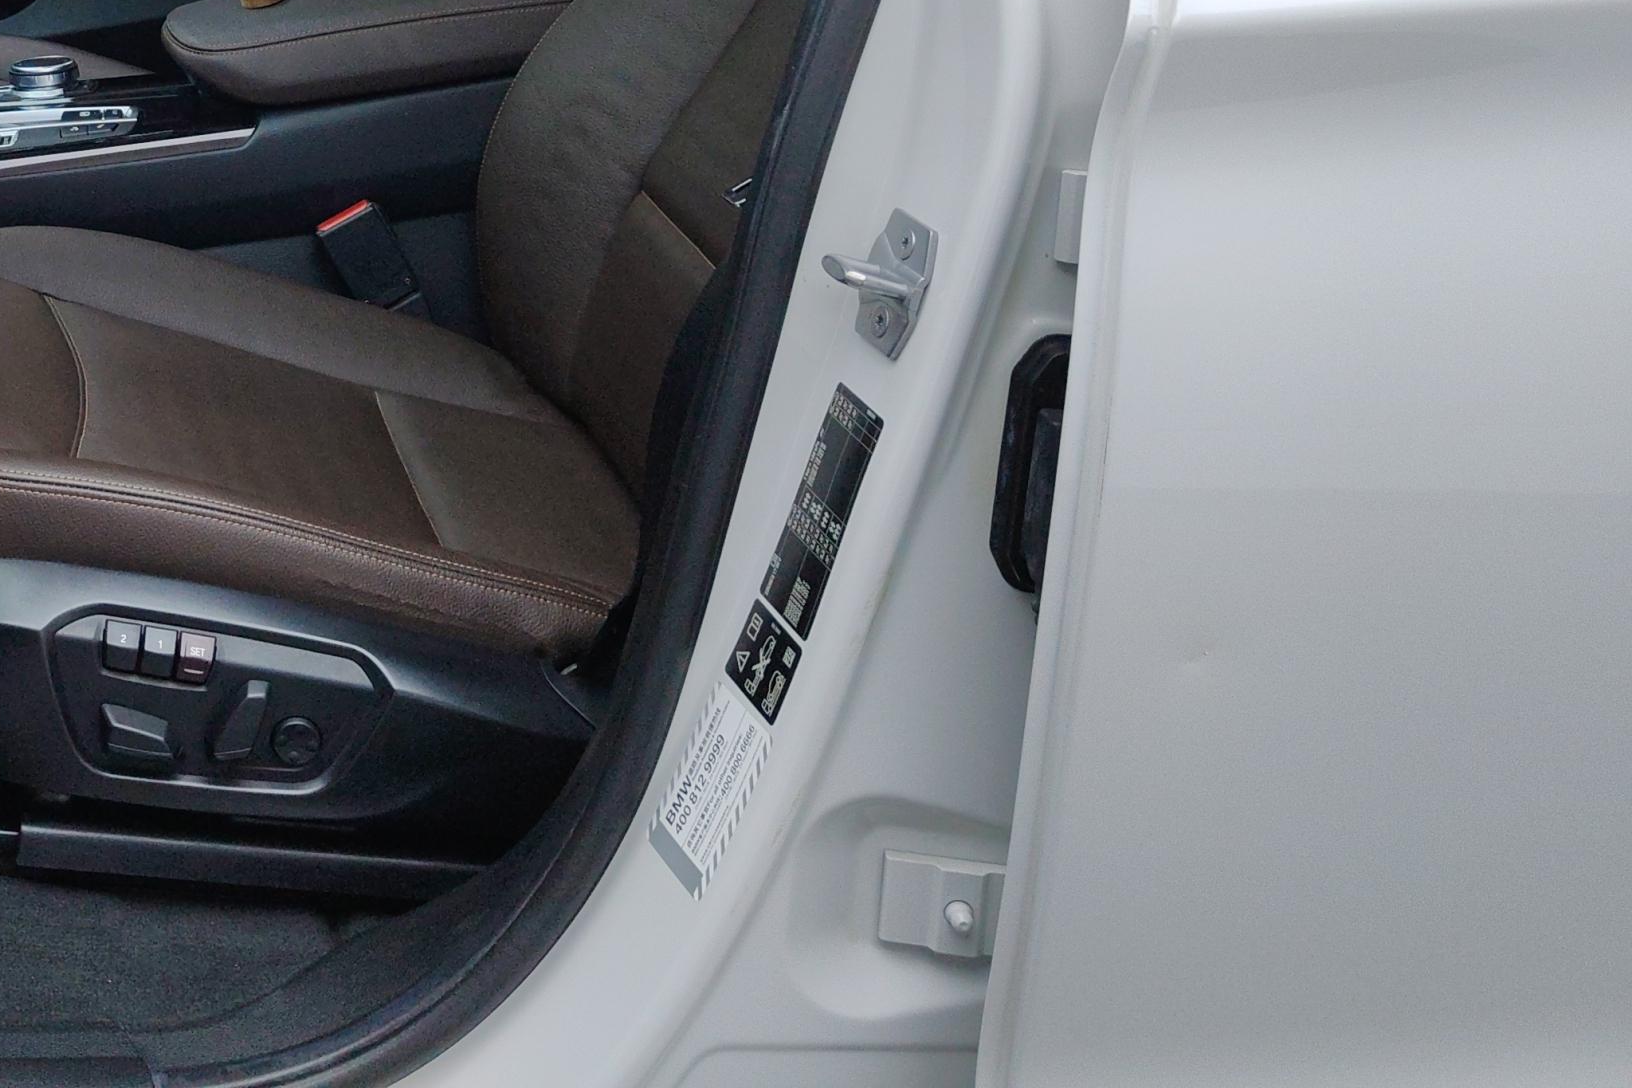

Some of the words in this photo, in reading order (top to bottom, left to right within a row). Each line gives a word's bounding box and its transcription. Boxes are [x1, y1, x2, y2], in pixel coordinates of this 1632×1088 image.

[120, 634, 127, 643] 2
[157, 639, 163, 649] 1
[190, 646, 206, 657] SET
[718, 772, 733, 797] 400
[728, 750, 743, 776] 800
[739, 723, 756, 754] 6666
[665, 773, 693, 826] BMW
[673, 802, 692, 836] 400
[688, 772, 707, 805] 812
[703, 732, 726, 775] 9999
